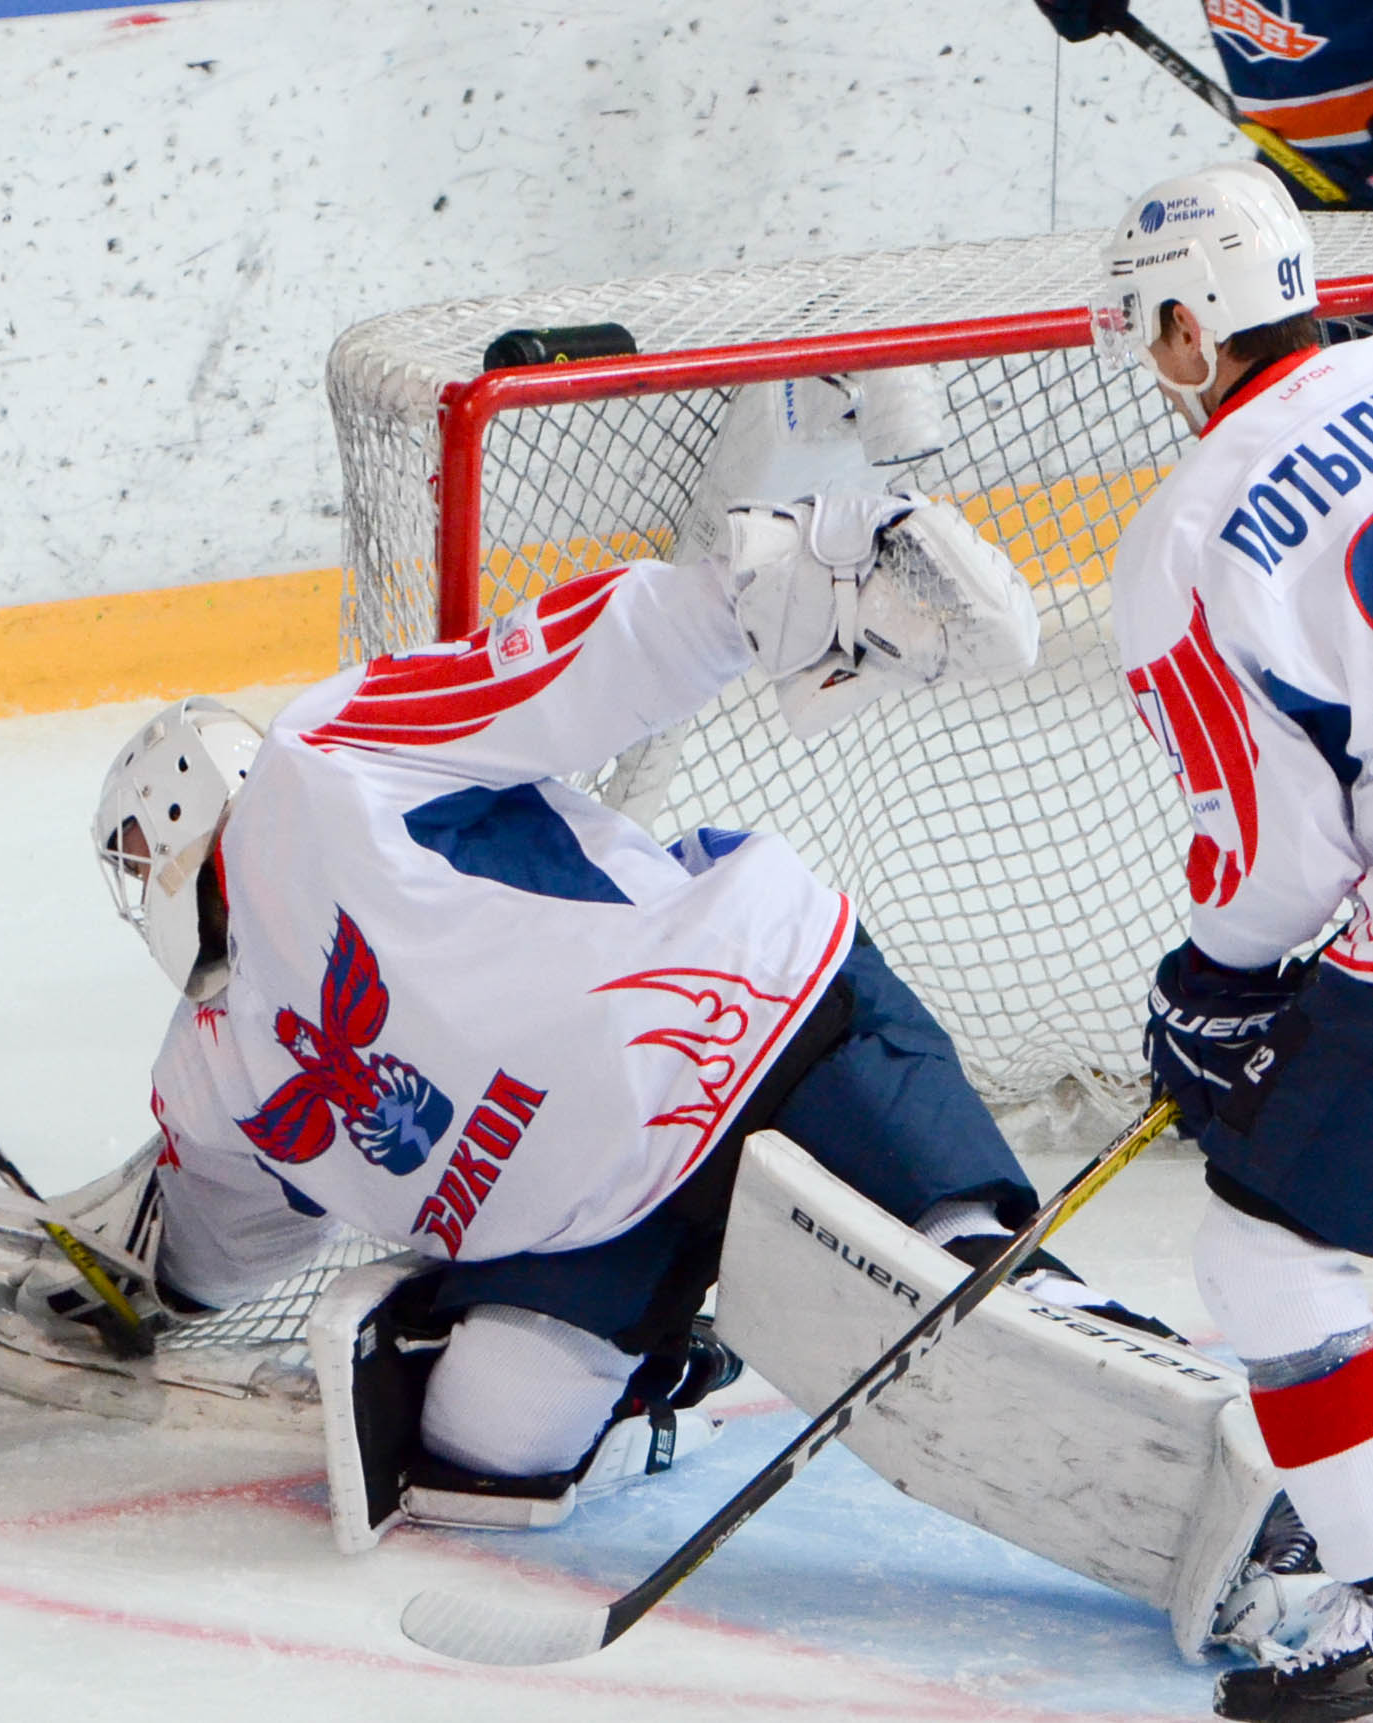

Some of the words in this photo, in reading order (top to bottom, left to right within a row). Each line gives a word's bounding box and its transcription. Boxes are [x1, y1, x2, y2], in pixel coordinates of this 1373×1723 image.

[1165, 207, 1216, 224] СИБИРИ
[1166, 196, 1199, 211] МРСК
[1277, 251, 1306, 302] 91
[1278, 364, 1336, 402] LUTCH
[410, 1066, 549, 1262] СОКОЛ
